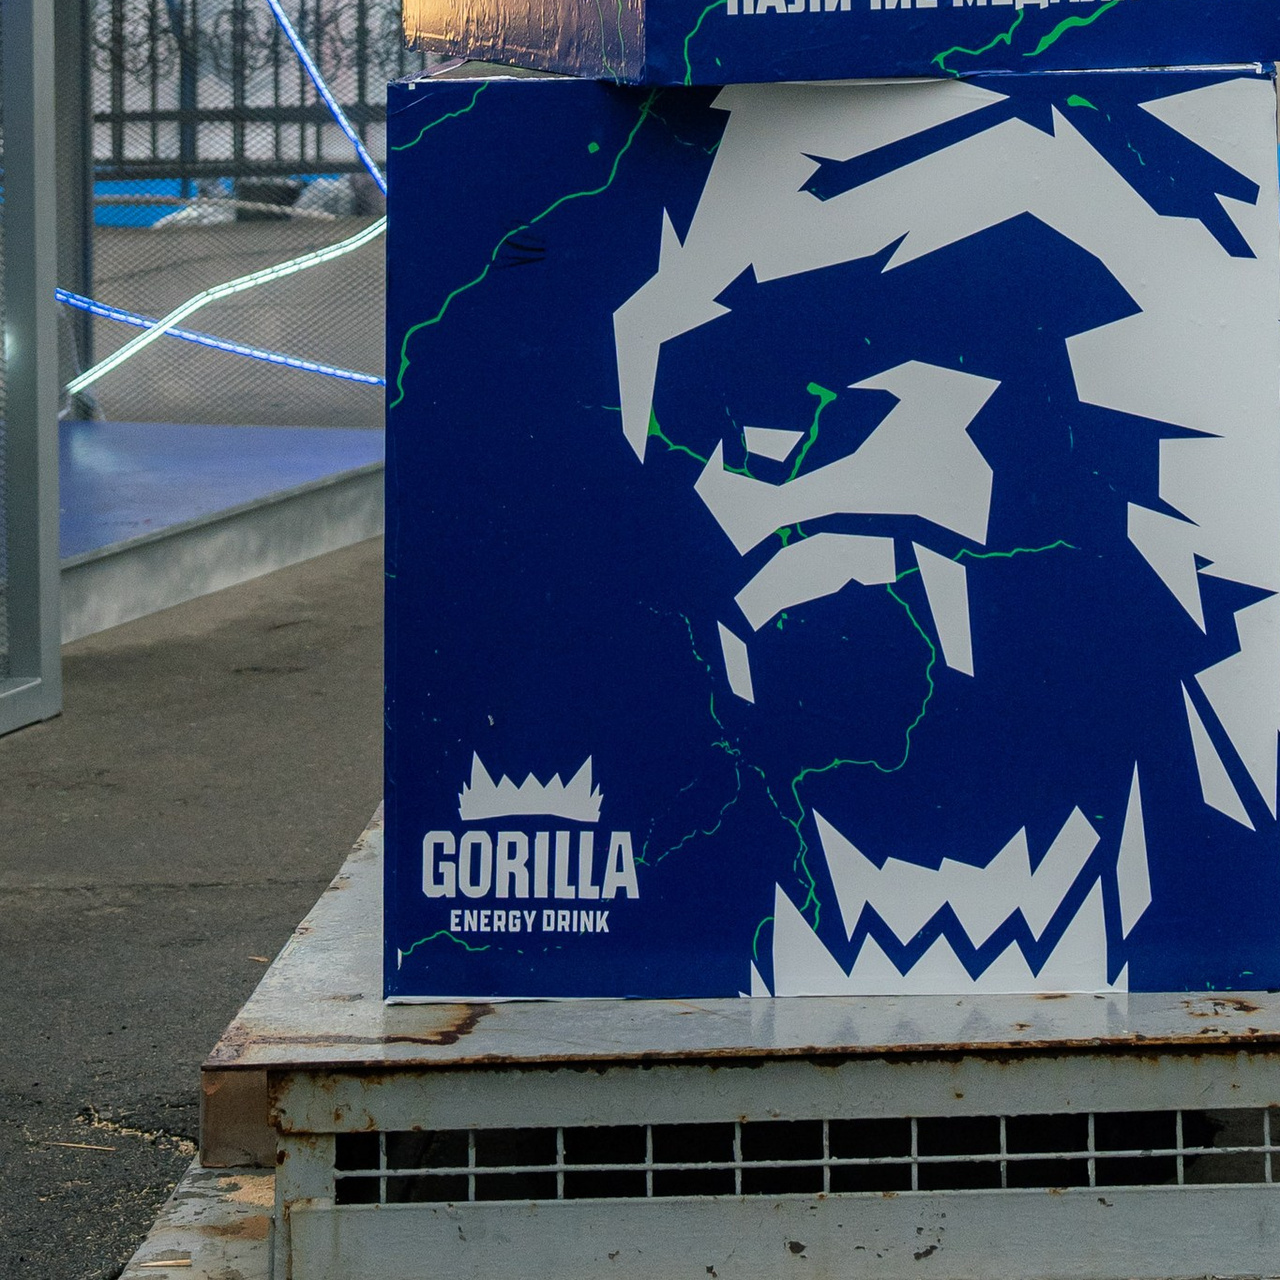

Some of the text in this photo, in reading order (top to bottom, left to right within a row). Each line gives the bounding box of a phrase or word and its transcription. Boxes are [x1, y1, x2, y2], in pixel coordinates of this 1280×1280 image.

[422, 829, 640, 900] GORILLA
[450, 909, 610, 933] ENERGY DRINK
